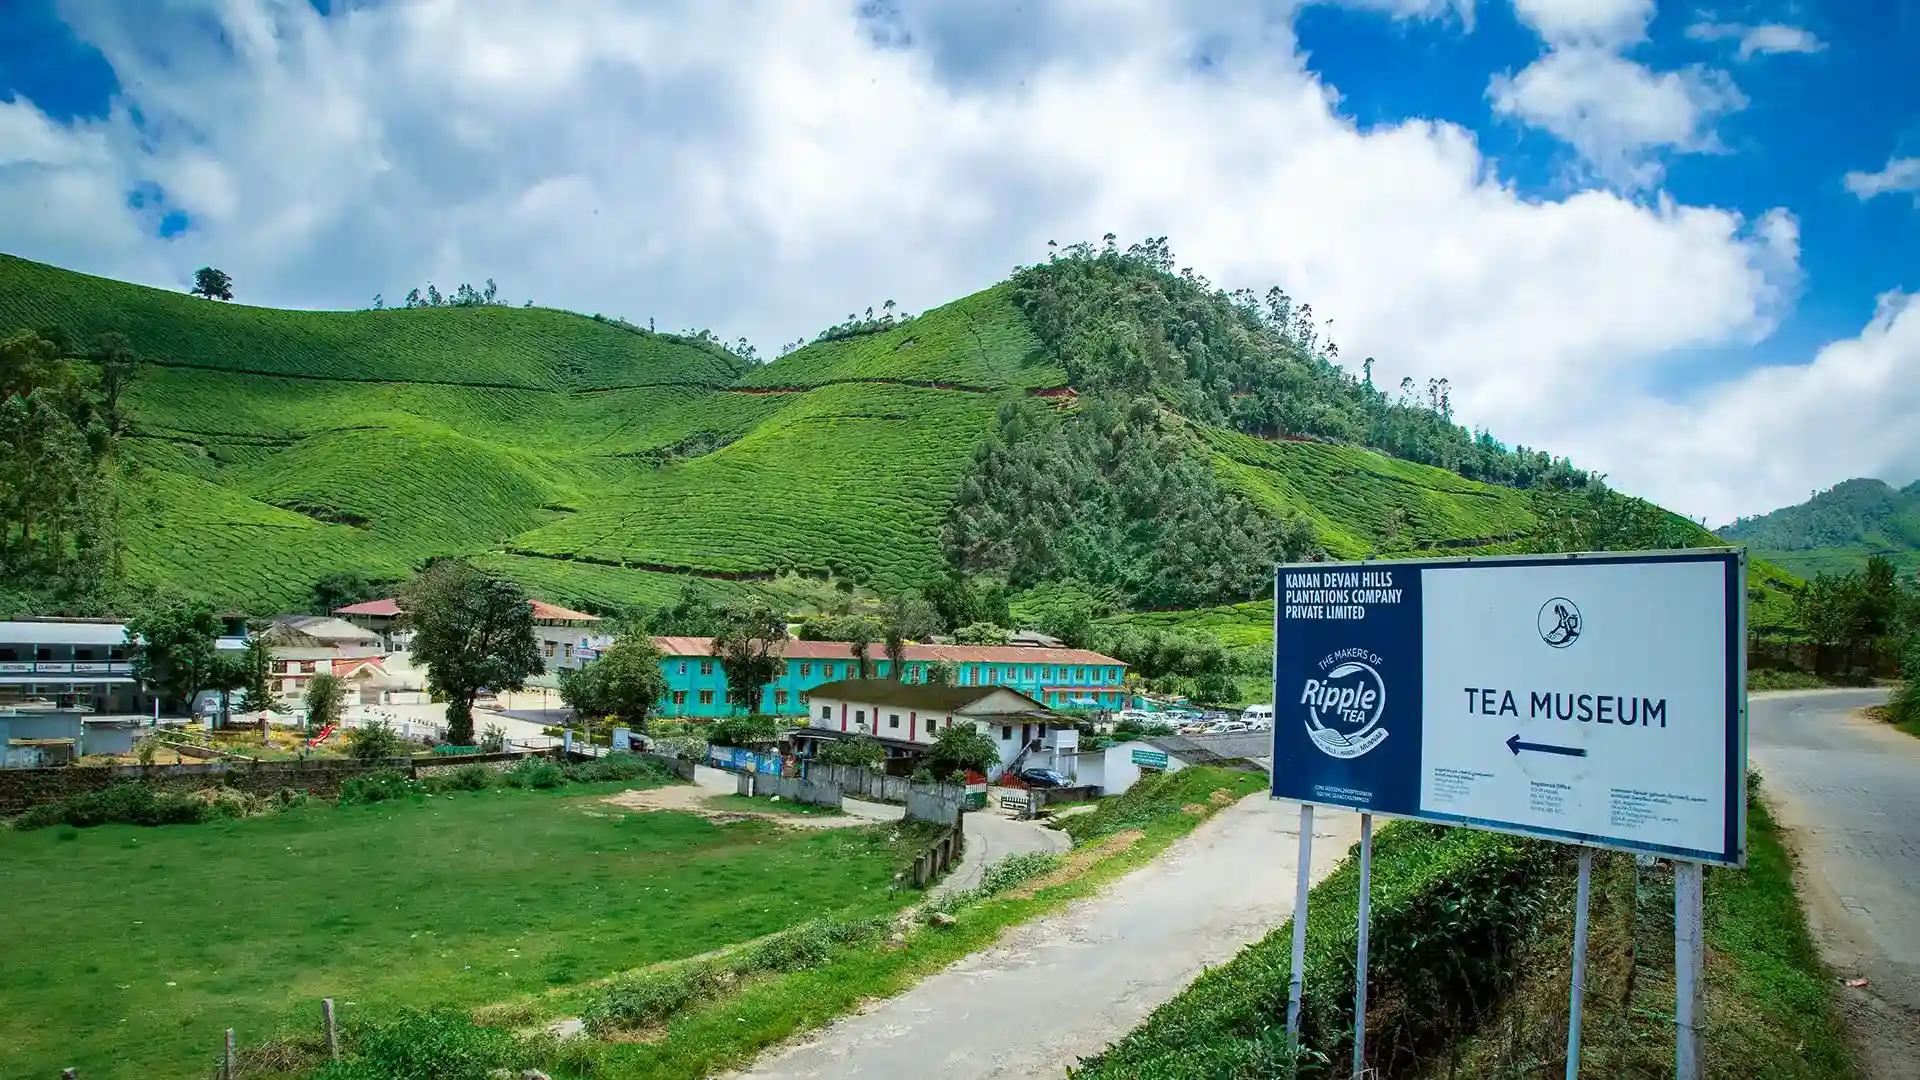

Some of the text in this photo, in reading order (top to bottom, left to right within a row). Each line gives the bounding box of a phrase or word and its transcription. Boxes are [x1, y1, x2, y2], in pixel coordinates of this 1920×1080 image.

[1285, 571, 1393, 588] KANAN DEVAN HILLS
[1285, 589, 1403, 604] PLANTATIONS COMPANY
[1285, 605, 1365, 620] PRIVATE LIMITED
[1317, 647, 1384, 671] THE MAKERS OF
[1300, 678, 1377, 715] Ripple
[1342, 708, 1366, 723] TEA
[1464, 687, 1667, 728] TEA MUSEUM
